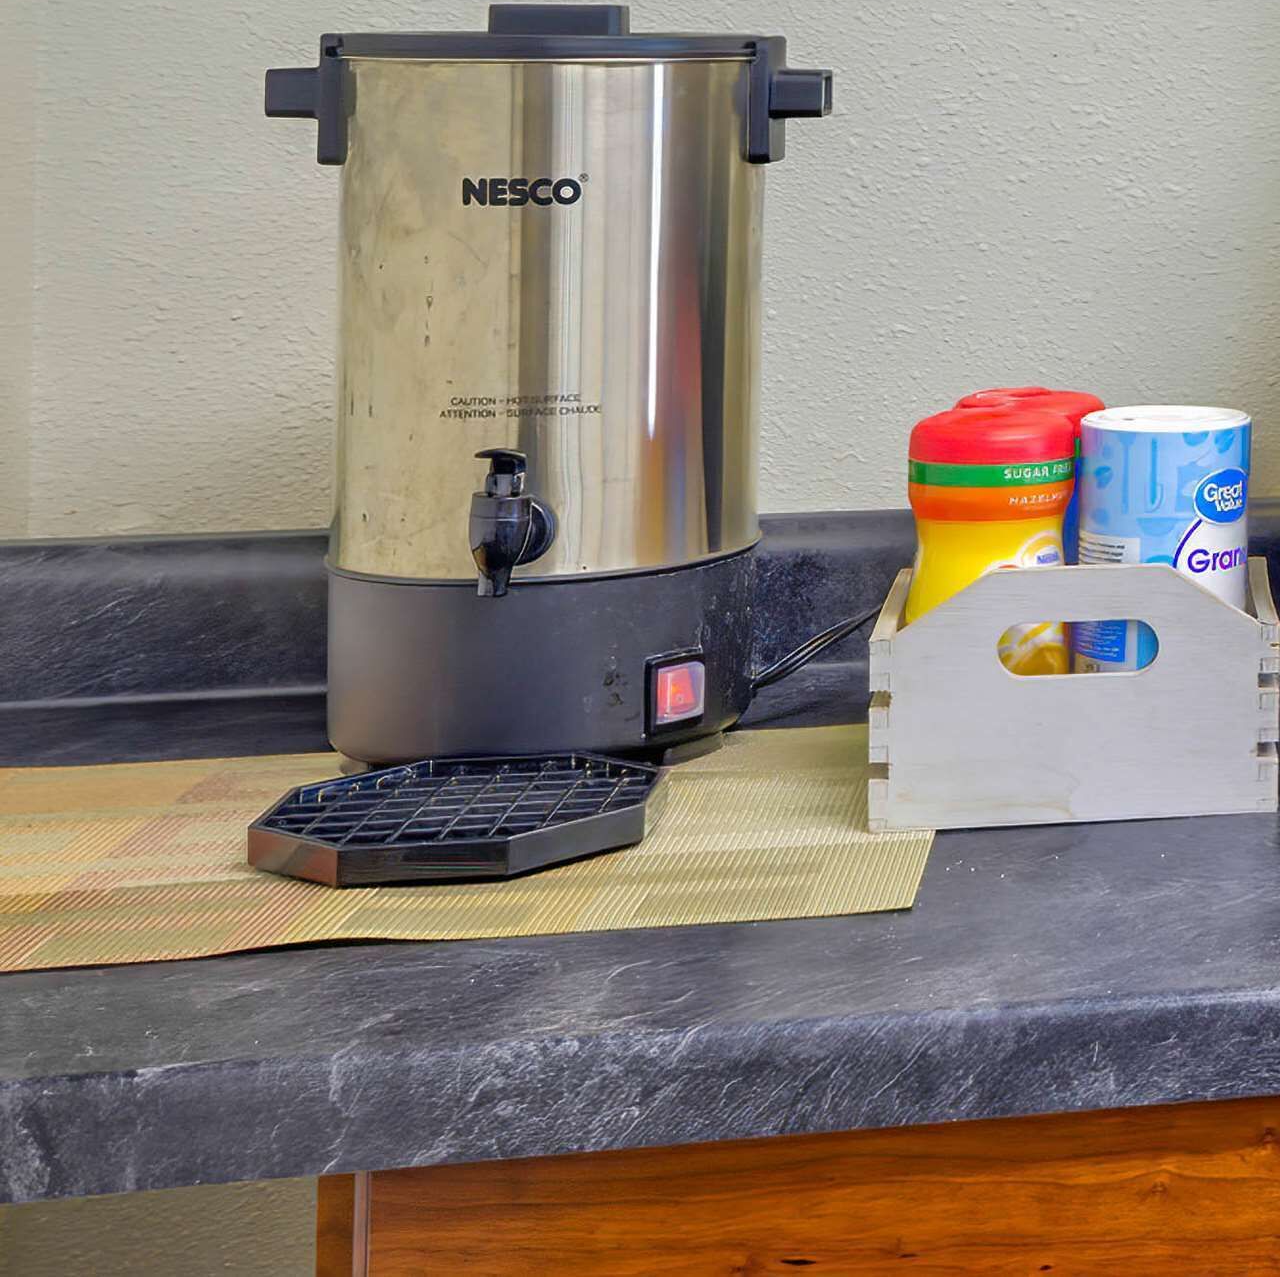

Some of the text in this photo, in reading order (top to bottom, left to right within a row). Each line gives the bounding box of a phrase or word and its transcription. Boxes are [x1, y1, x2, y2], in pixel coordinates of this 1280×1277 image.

[462, 178, 581, 206] NESCO
[450, 396, 496, 406] CAUTION
[439, 408, 496, 419] ATTENTION
[1004, 466, 1049, 479] SUGAR
